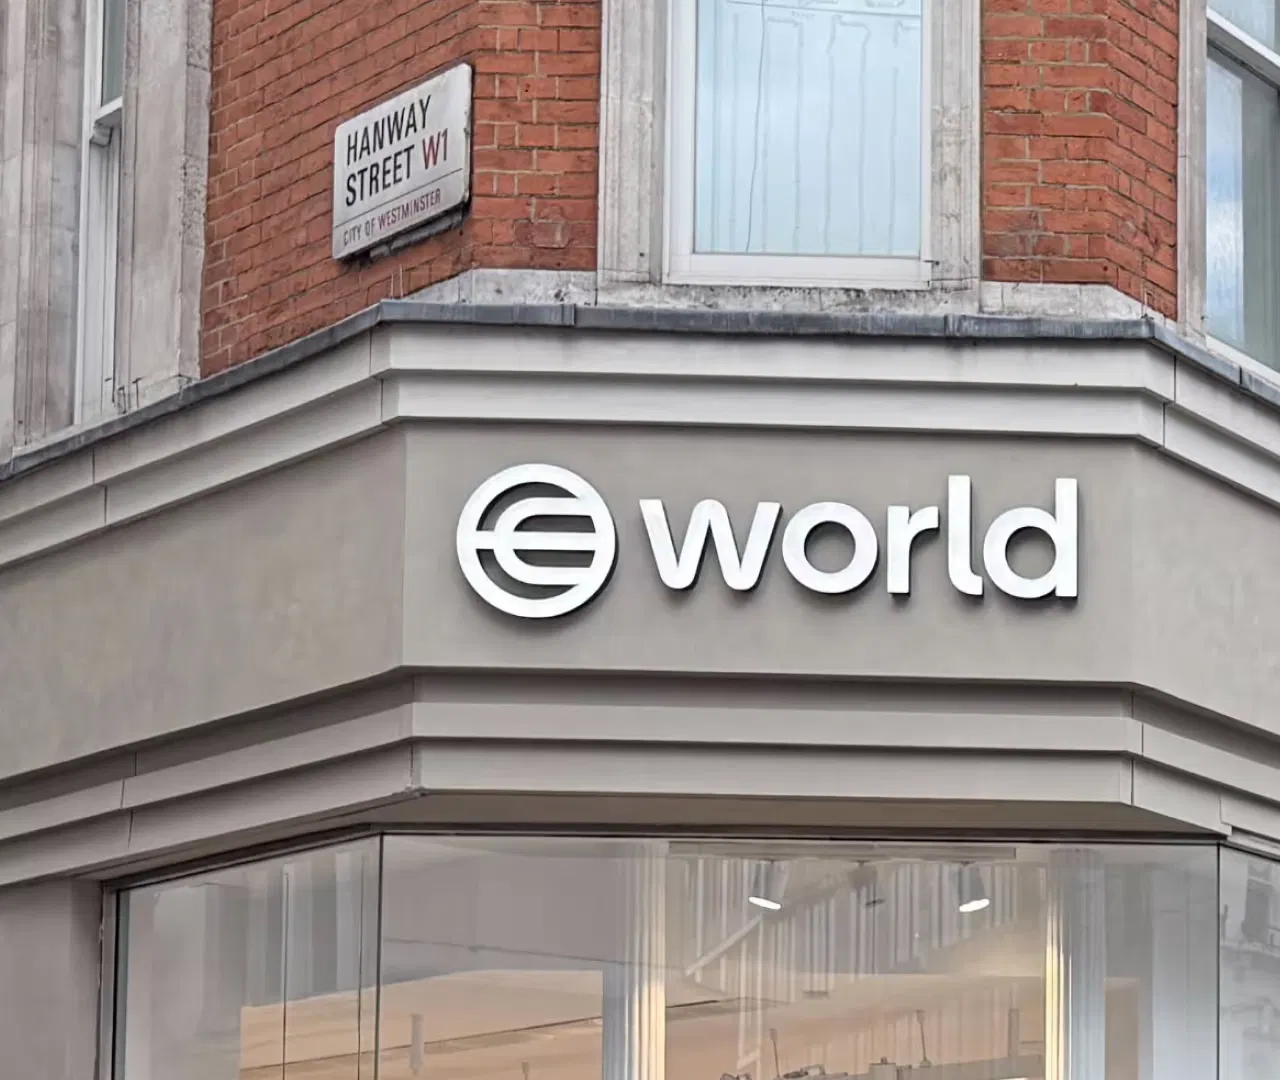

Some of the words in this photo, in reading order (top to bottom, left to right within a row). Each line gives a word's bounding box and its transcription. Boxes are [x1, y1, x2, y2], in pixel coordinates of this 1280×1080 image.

[346, 145, 415, 207] STREET
[422, 128, 448, 170] W1
[347, 95, 431, 166] HANWAY
[343, 223, 361, 246] CITY
[365, 219, 376, 235] OF
[377, 188, 441, 230] WESTMINSTER
[639, 475, 1078, 600] world
